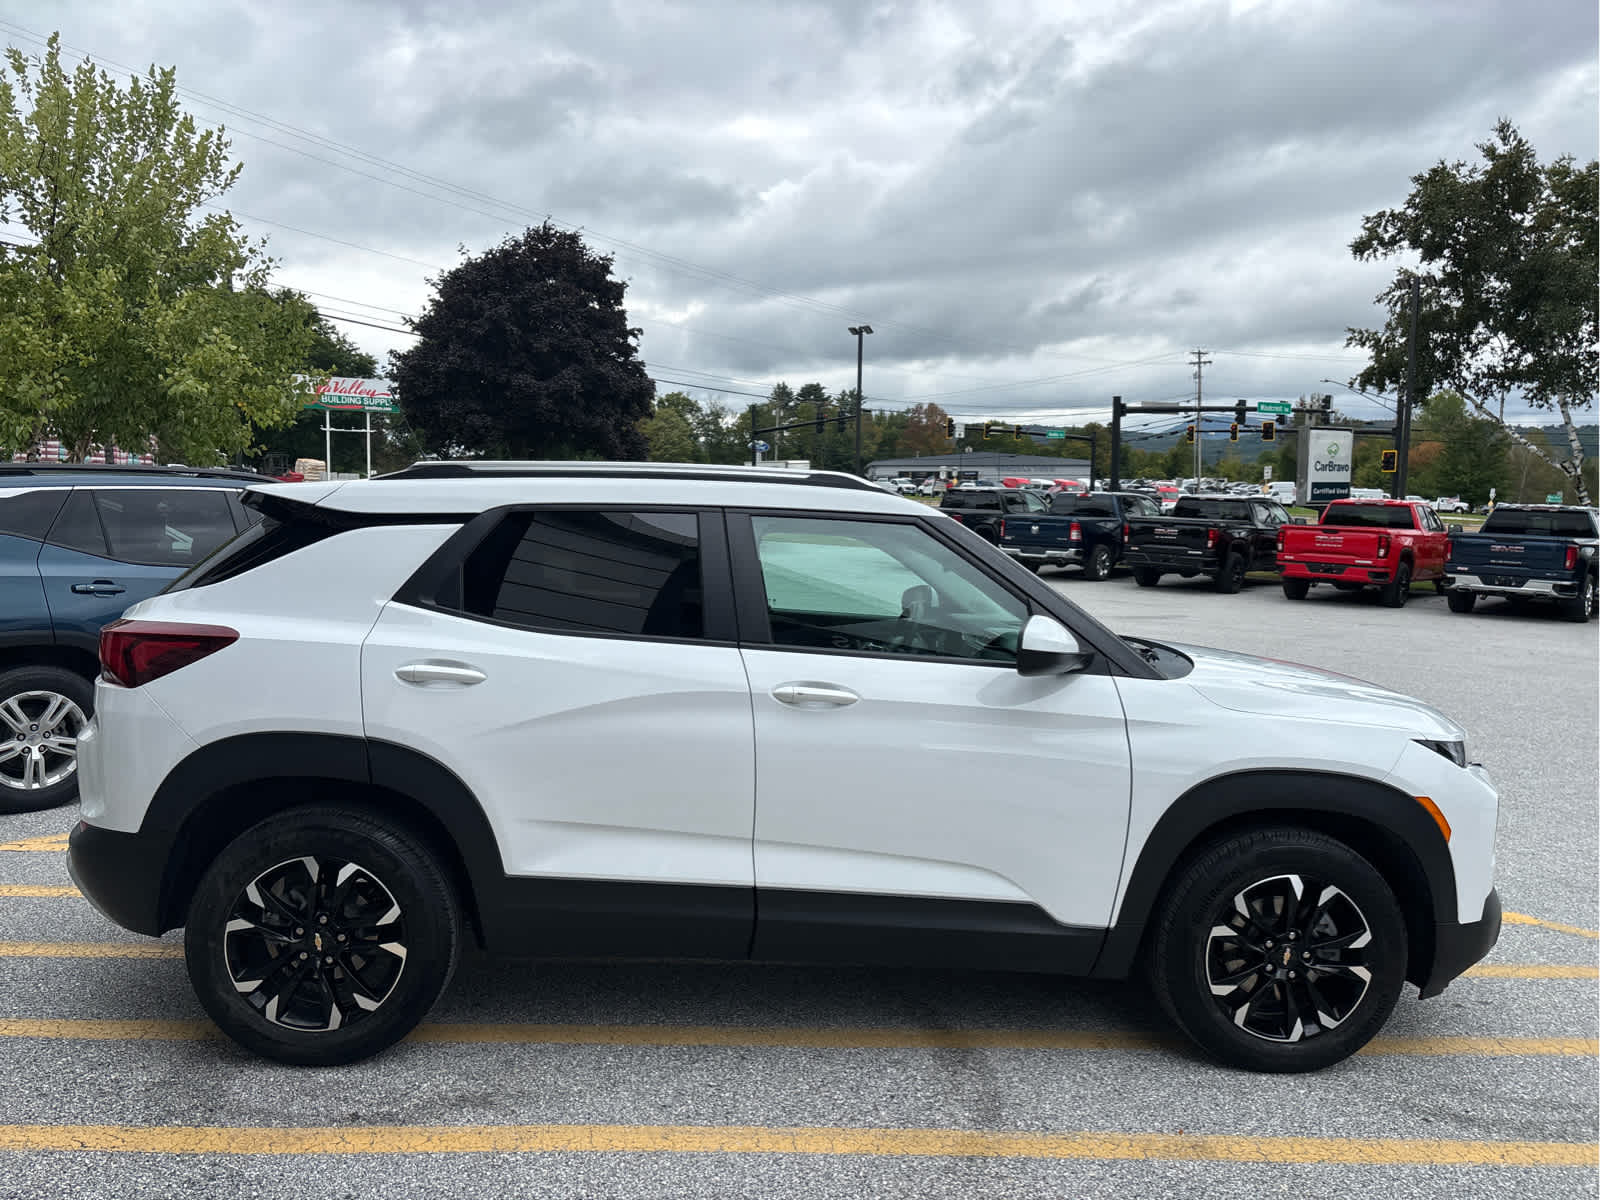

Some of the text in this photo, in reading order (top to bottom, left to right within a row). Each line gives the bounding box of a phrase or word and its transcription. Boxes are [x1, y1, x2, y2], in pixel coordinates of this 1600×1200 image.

[321, 394, 361, 404] BUILDING
[1314, 460, 1350, 472] CarBravo
[1313, 487, 1336, 495] Certified
